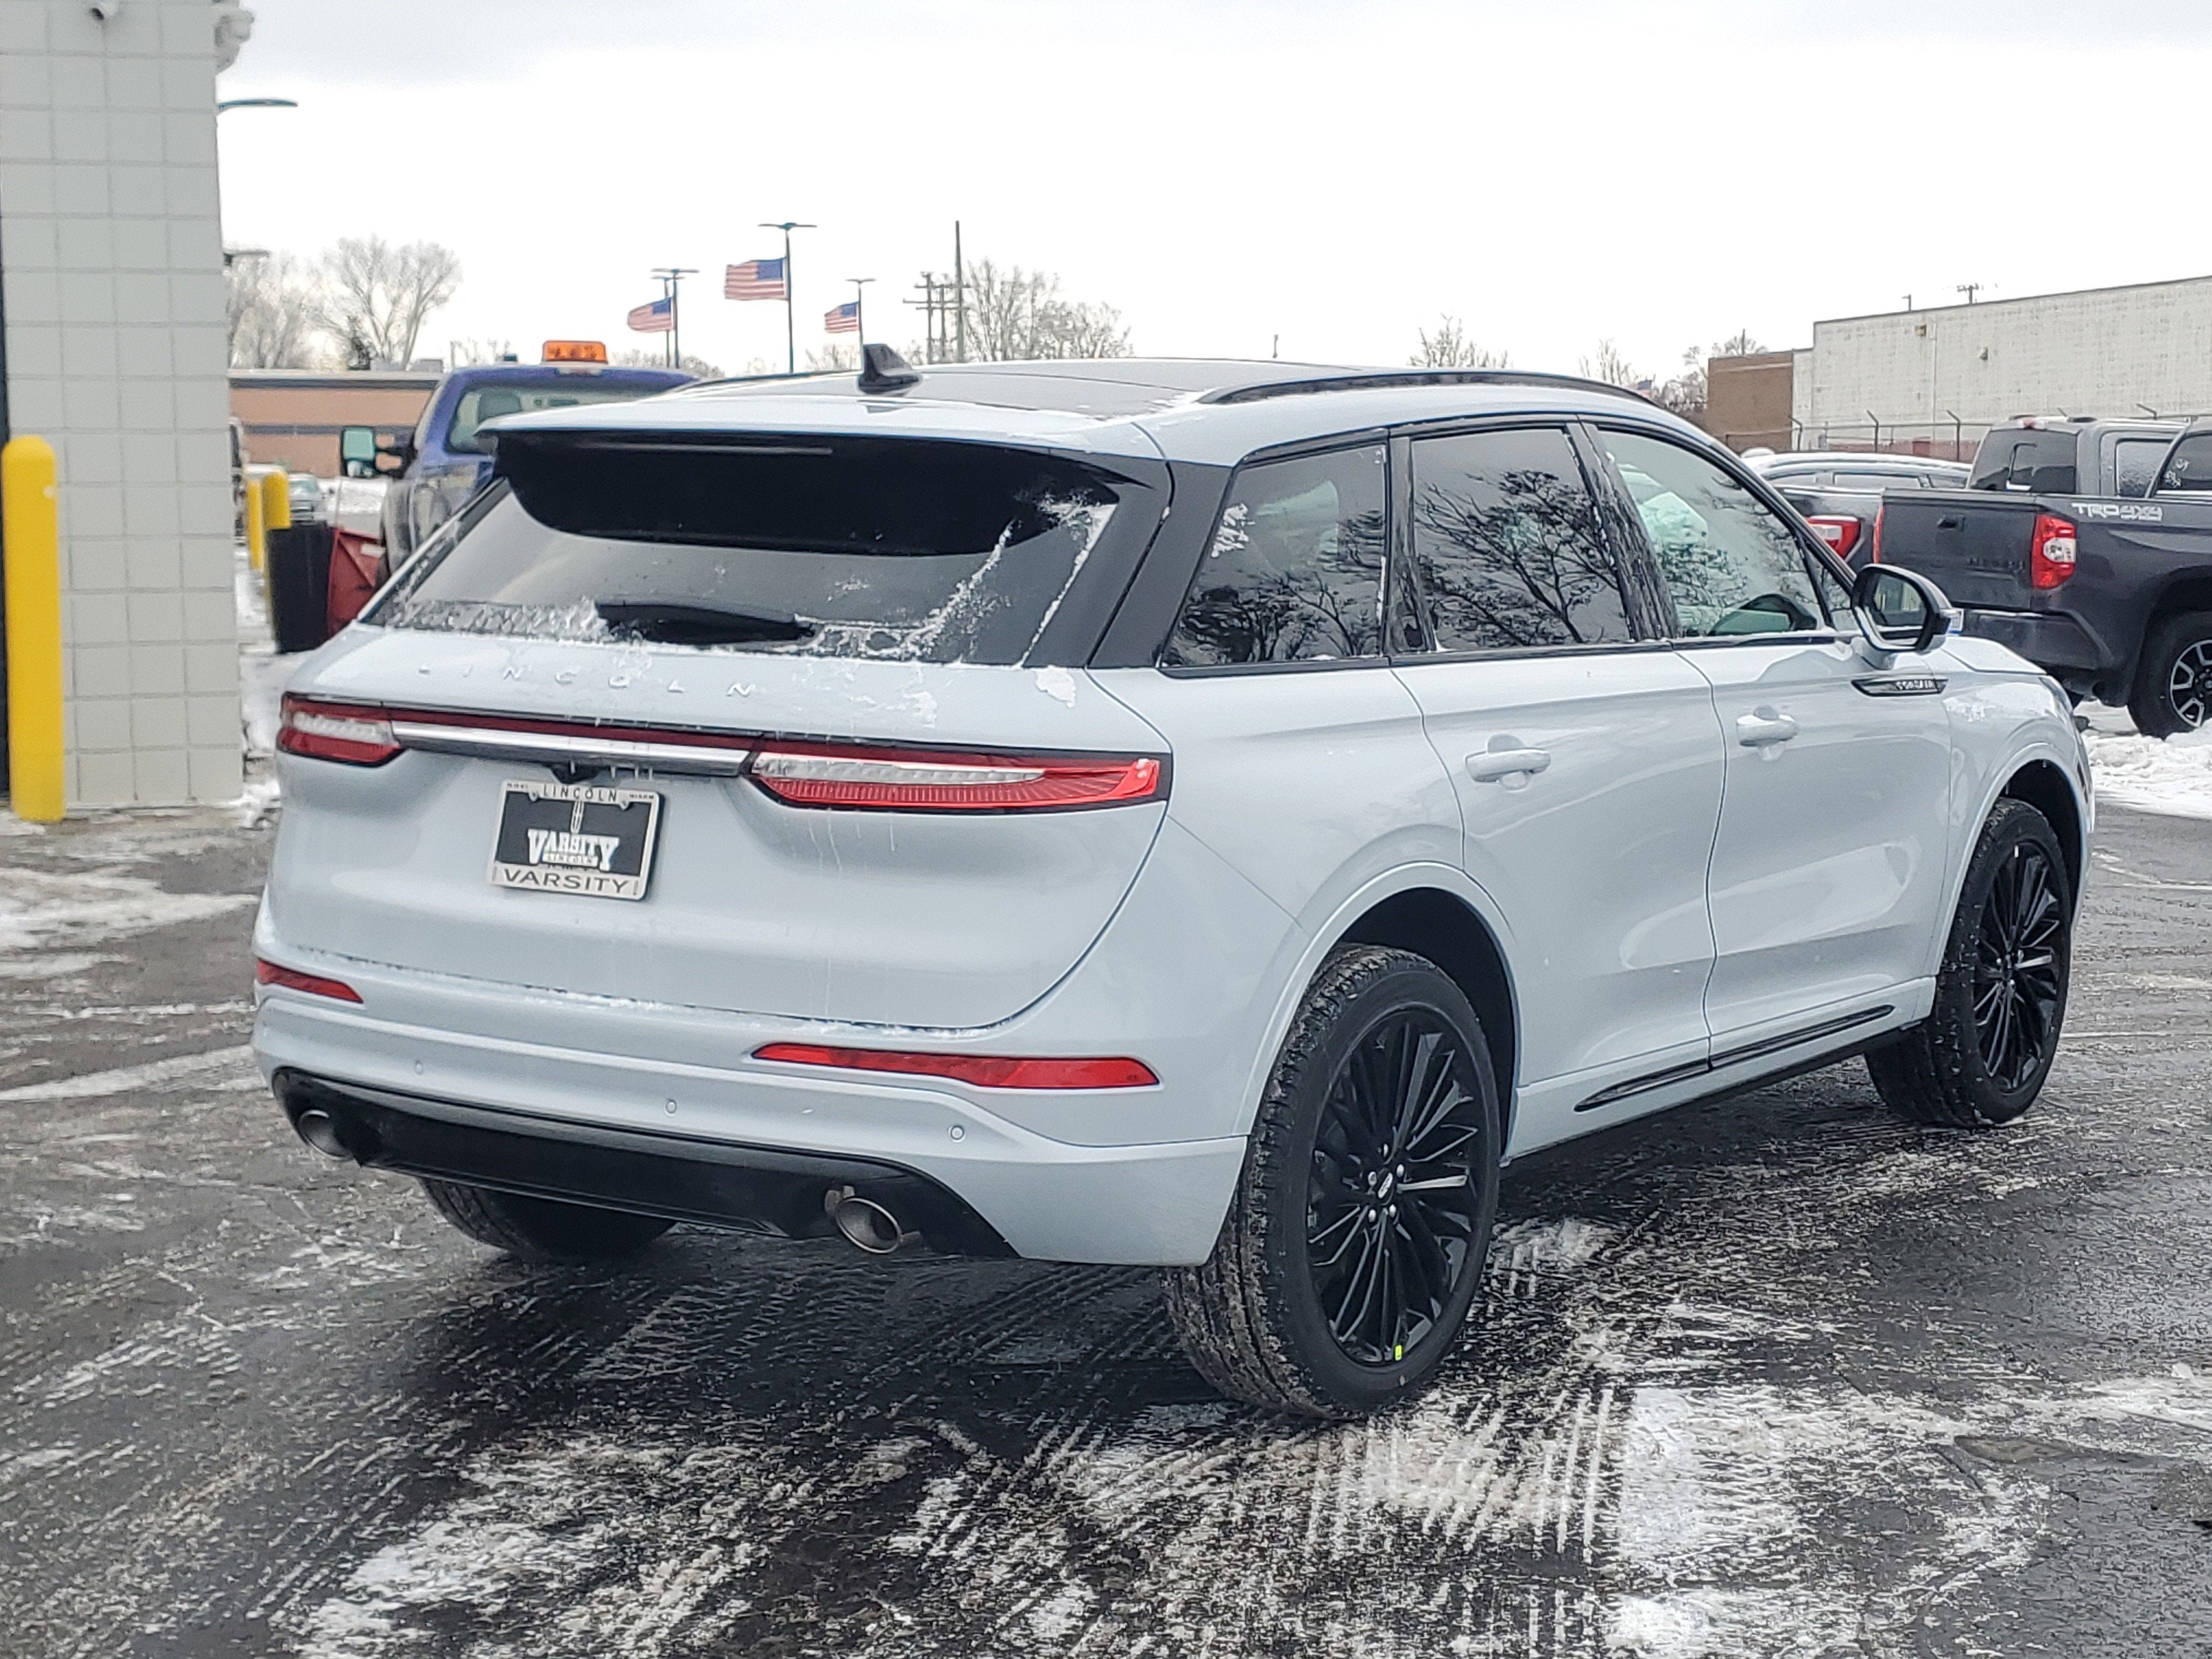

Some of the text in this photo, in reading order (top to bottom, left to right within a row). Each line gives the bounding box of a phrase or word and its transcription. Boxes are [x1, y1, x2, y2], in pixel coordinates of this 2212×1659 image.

[543, 783, 618, 803] LINCOLN
[527, 828, 619, 872] VARSITY
[504, 868, 629, 894] VARSITY
